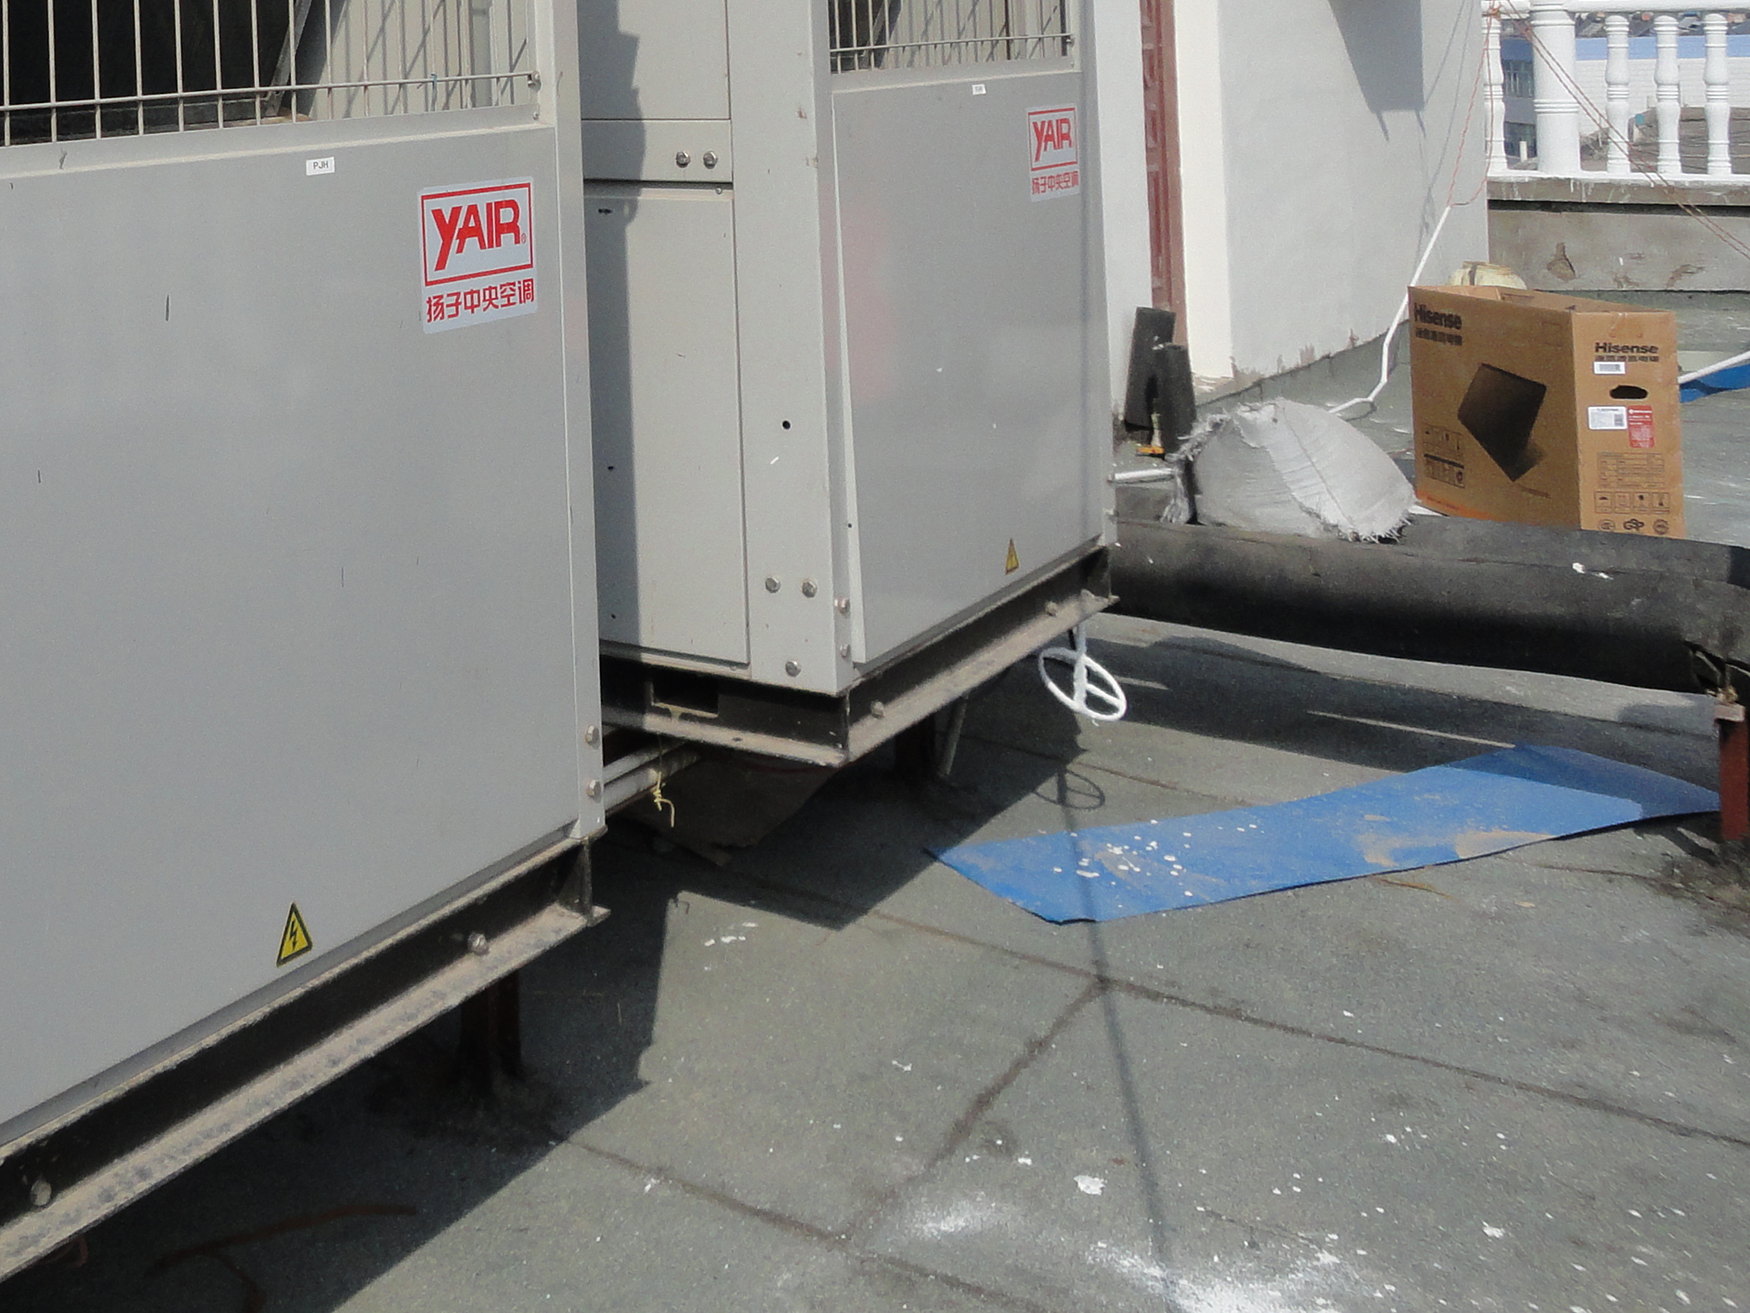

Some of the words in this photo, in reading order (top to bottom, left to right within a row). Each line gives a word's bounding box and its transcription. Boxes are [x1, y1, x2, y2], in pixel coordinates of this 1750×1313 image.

[1033, 118, 1072, 161] YAIR
[313, 161, 329, 169] PJH
[431, 199, 520, 271] YAIR
[426, 278, 534, 323] 扬子中央空调
[1414, 302, 1462, 330] Hisense
[1594, 342, 1658, 354] Hisense
